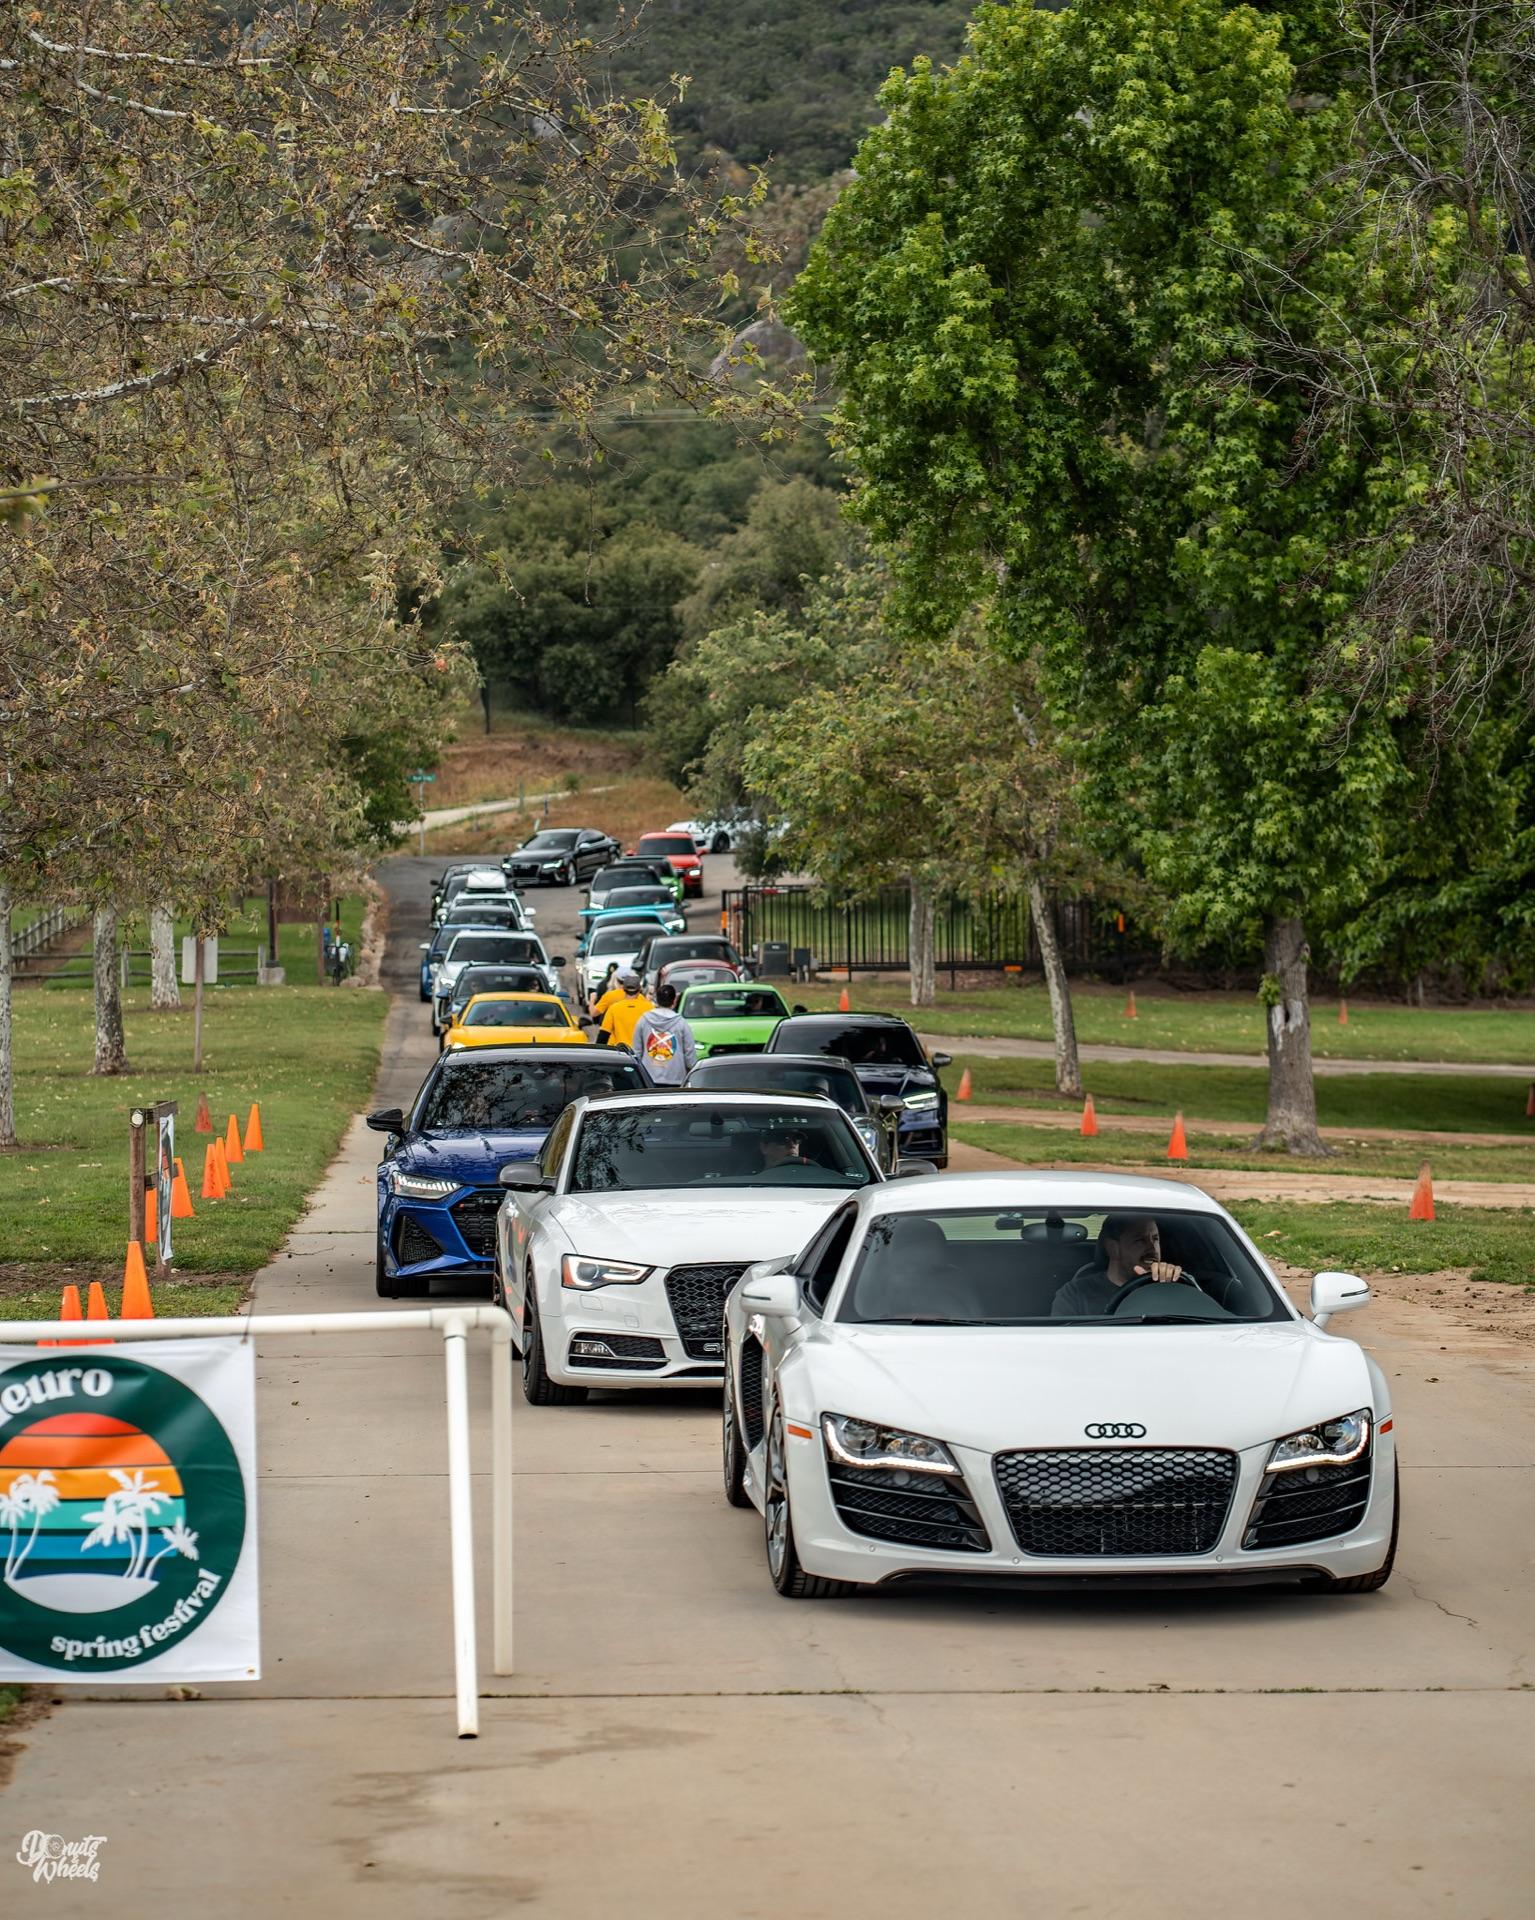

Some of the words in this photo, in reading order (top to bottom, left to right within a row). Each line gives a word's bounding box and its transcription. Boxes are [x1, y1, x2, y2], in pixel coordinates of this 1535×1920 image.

[0, 1368, 114, 1414] euro
[51, 1635, 143, 1661] spring
[139, 1568, 222, 1648] festival
